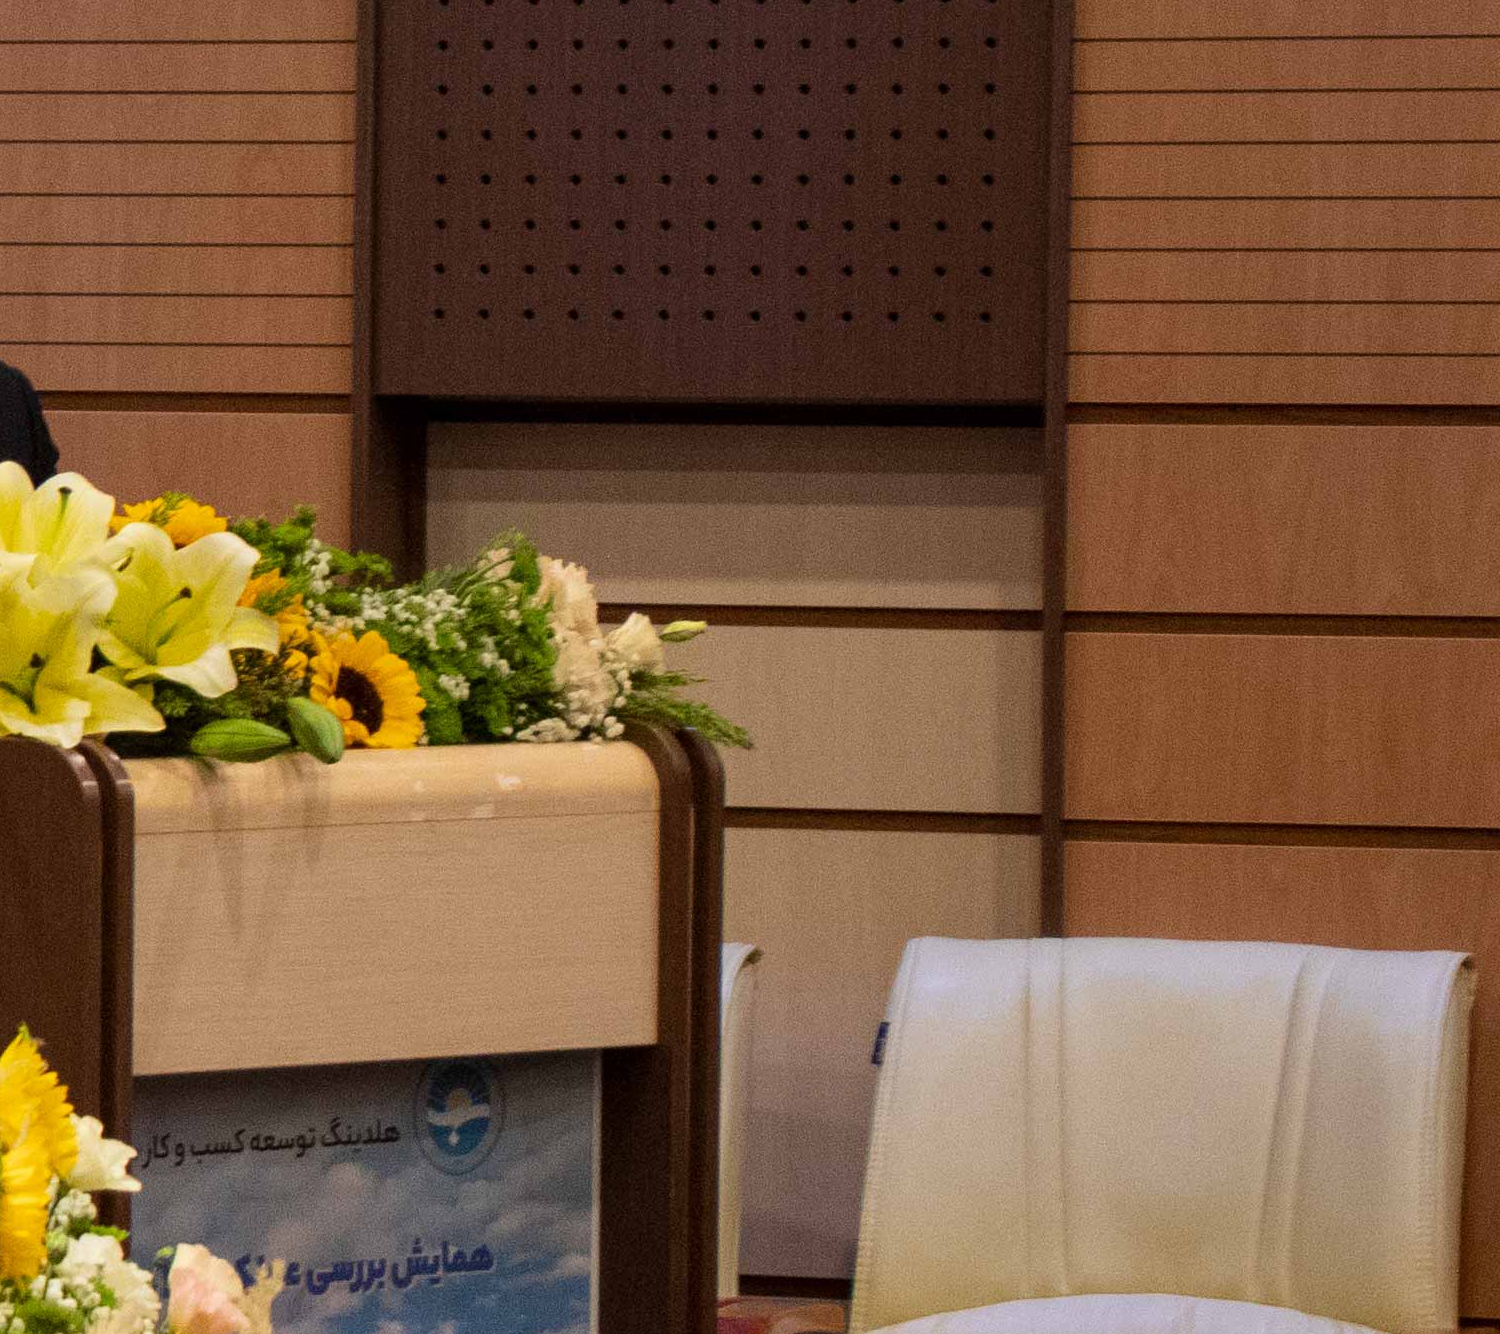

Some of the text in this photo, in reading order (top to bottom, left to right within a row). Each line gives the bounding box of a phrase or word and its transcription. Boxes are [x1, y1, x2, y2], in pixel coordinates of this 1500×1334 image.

[191, 1128, 247, 1165] کسب
[250, 1127, 316, 1159] توسعه
[320, 1117, 401, 1154] هلدینگ
[174, 1142, 186, 1167] و
[306, 1257, 387, 1296] بررسی
[391, 1238, 495, 1284] همایش
